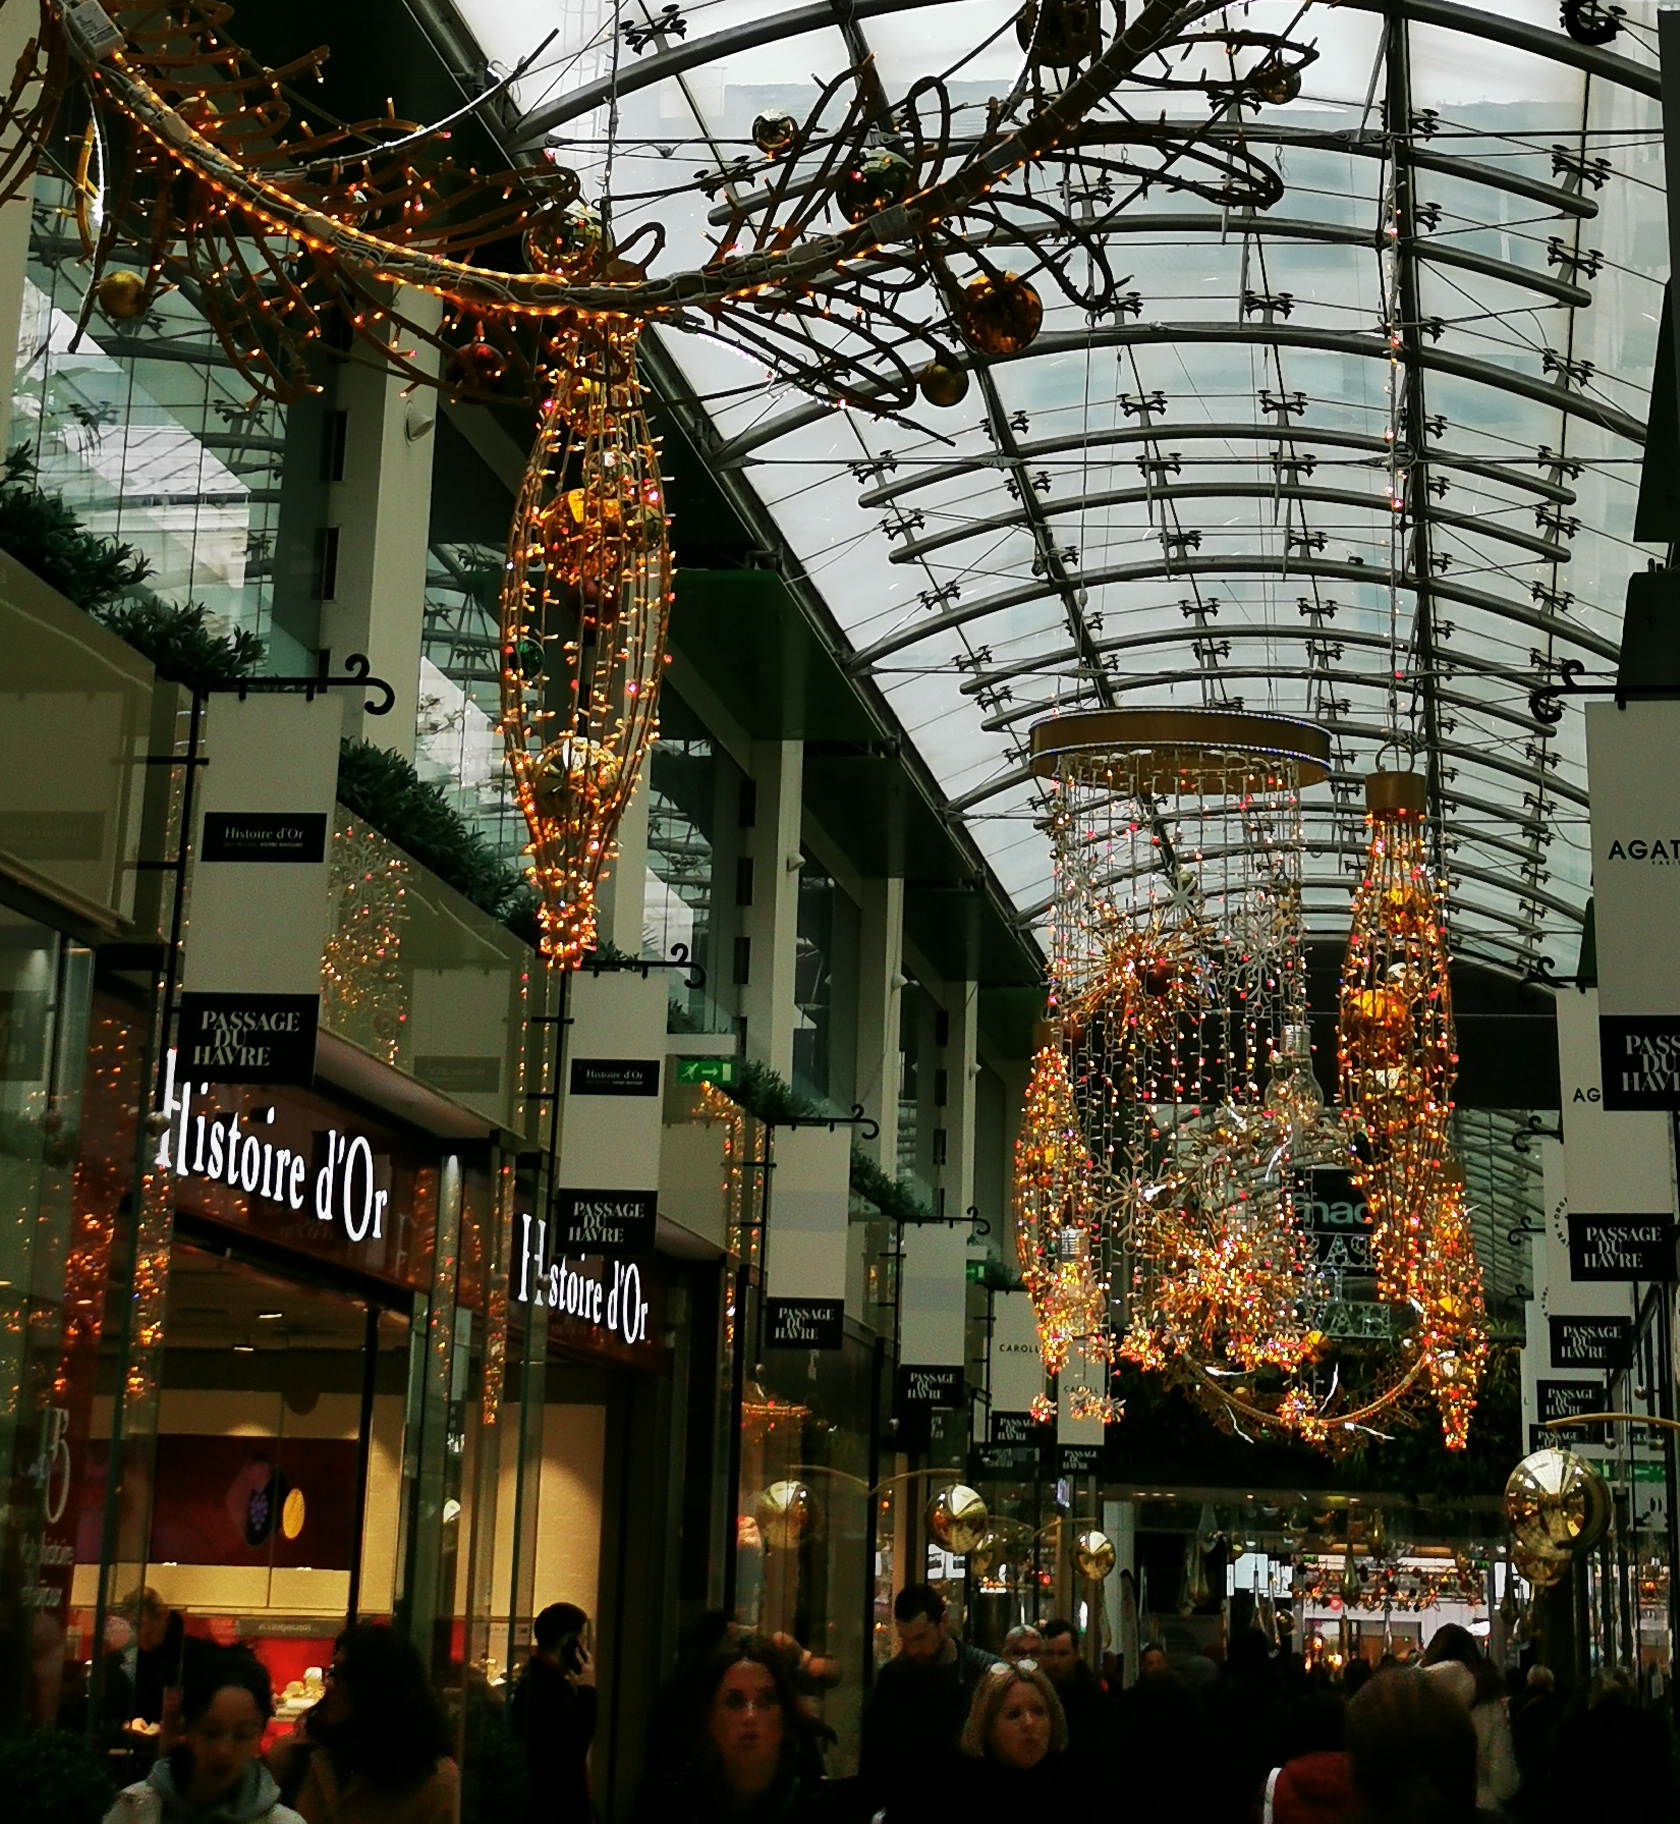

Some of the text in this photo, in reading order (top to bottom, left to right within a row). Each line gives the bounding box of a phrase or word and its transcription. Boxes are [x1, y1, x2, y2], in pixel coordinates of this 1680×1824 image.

[225, 827, 304, 840] Histoire d'Or
[201, 1010, 300, 1032] PASSAGE
[214, 1028, 247, 1048] DU
[193, 1045, 271, 1066] HAVRE
[1642, 1053, 1677, 1073] DU
[586, 1069, 621, 1079] Histoire
[154, 1048, 388, 1242] Histoire d'Or
[573, 1201, 645, 1218] PASSAGE
[583, 1214, 606, 1229] DU
[568, 1226, 624, 1243] HAVRE
[1585, 1227, 1663, 1242] PASSAGE
[1598, 1239, 1622, 1256] DU
[1583, 1253, 1643, 1268] HAVRE
[518, 1213, 649, 1344] Hstoire d'Or
[779, 1307, 835, 1321] PASSAGE
[787, 1317, 804, 1330] DU
[775, 1327, 819, 1340] HAVRE
[1563, 1325, 1622, 1338] PASSAGE
[1573, 1335, 1591, 1348] DU
[1561, 1346, 1607, 1358] HAVRE
[910, 1372, 955, 1384] PASSAGE
[907, 1388, 943, 1399] HAVRE
[1548, 1388, 1595, 1399] PASSAGE
[1546, 1405, 1582, 1415] HAVRE
